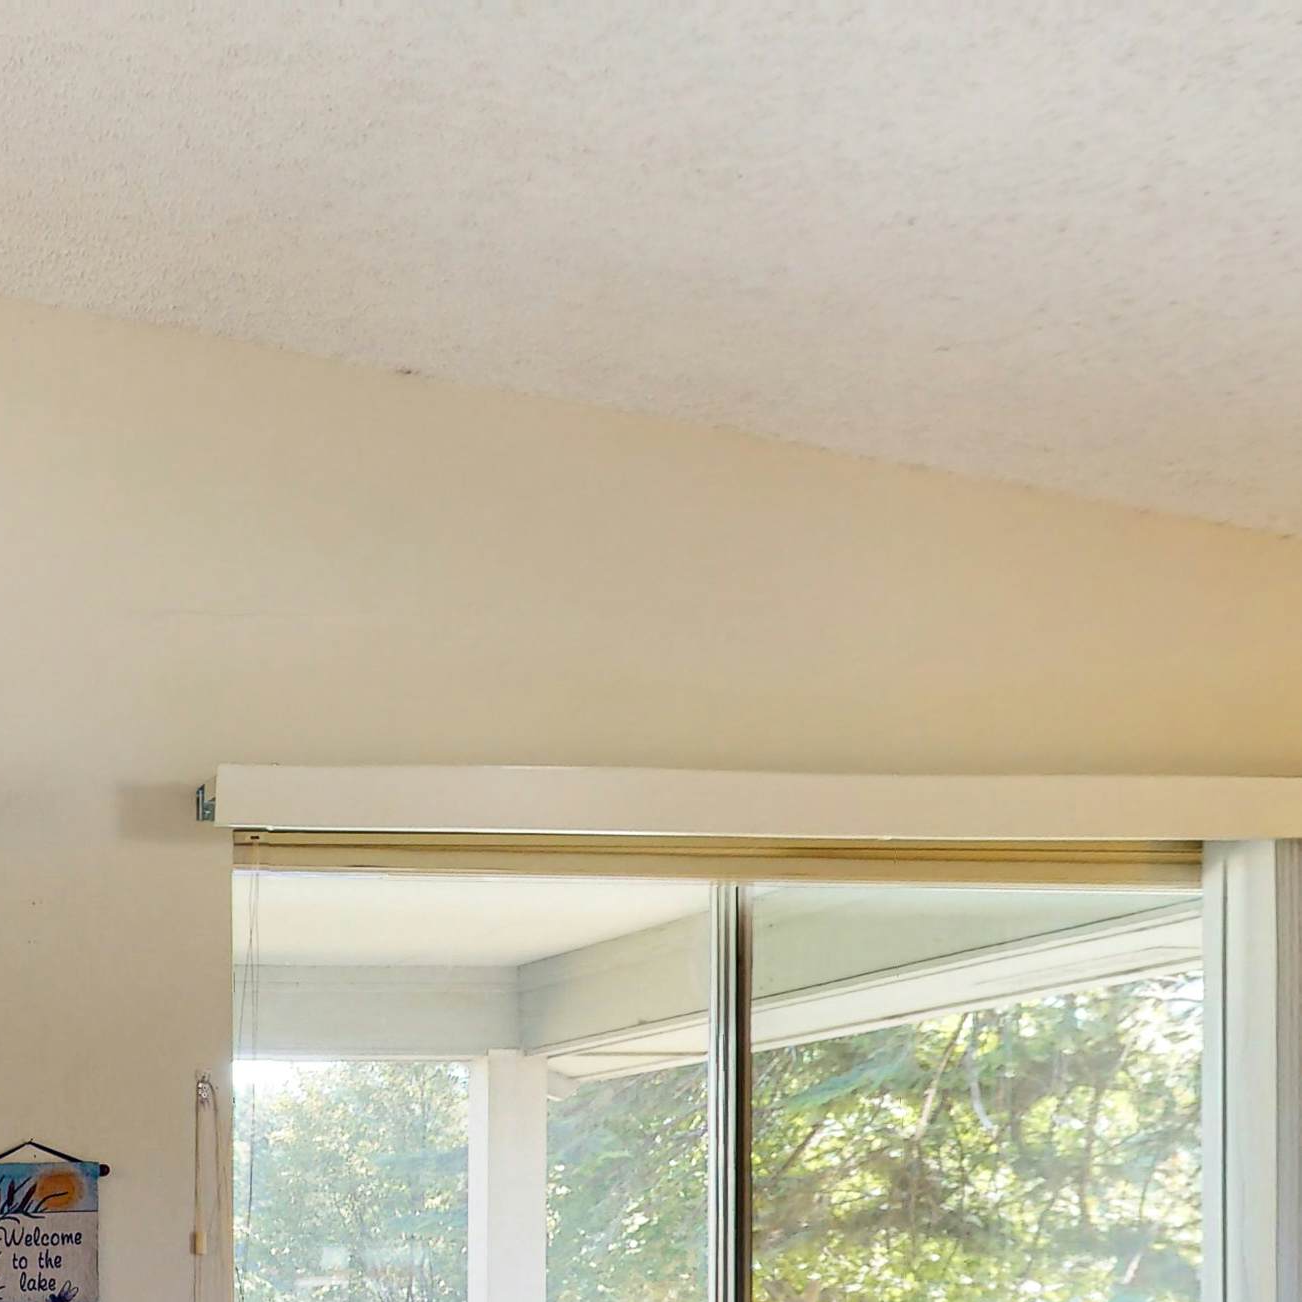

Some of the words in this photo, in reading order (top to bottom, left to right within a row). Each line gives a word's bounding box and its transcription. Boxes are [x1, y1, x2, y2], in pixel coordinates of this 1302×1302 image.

[12, 1253, 28, 1270] to
[38, 1250, 63, 1269] the
[19, 1272, 57, 1293] lake
